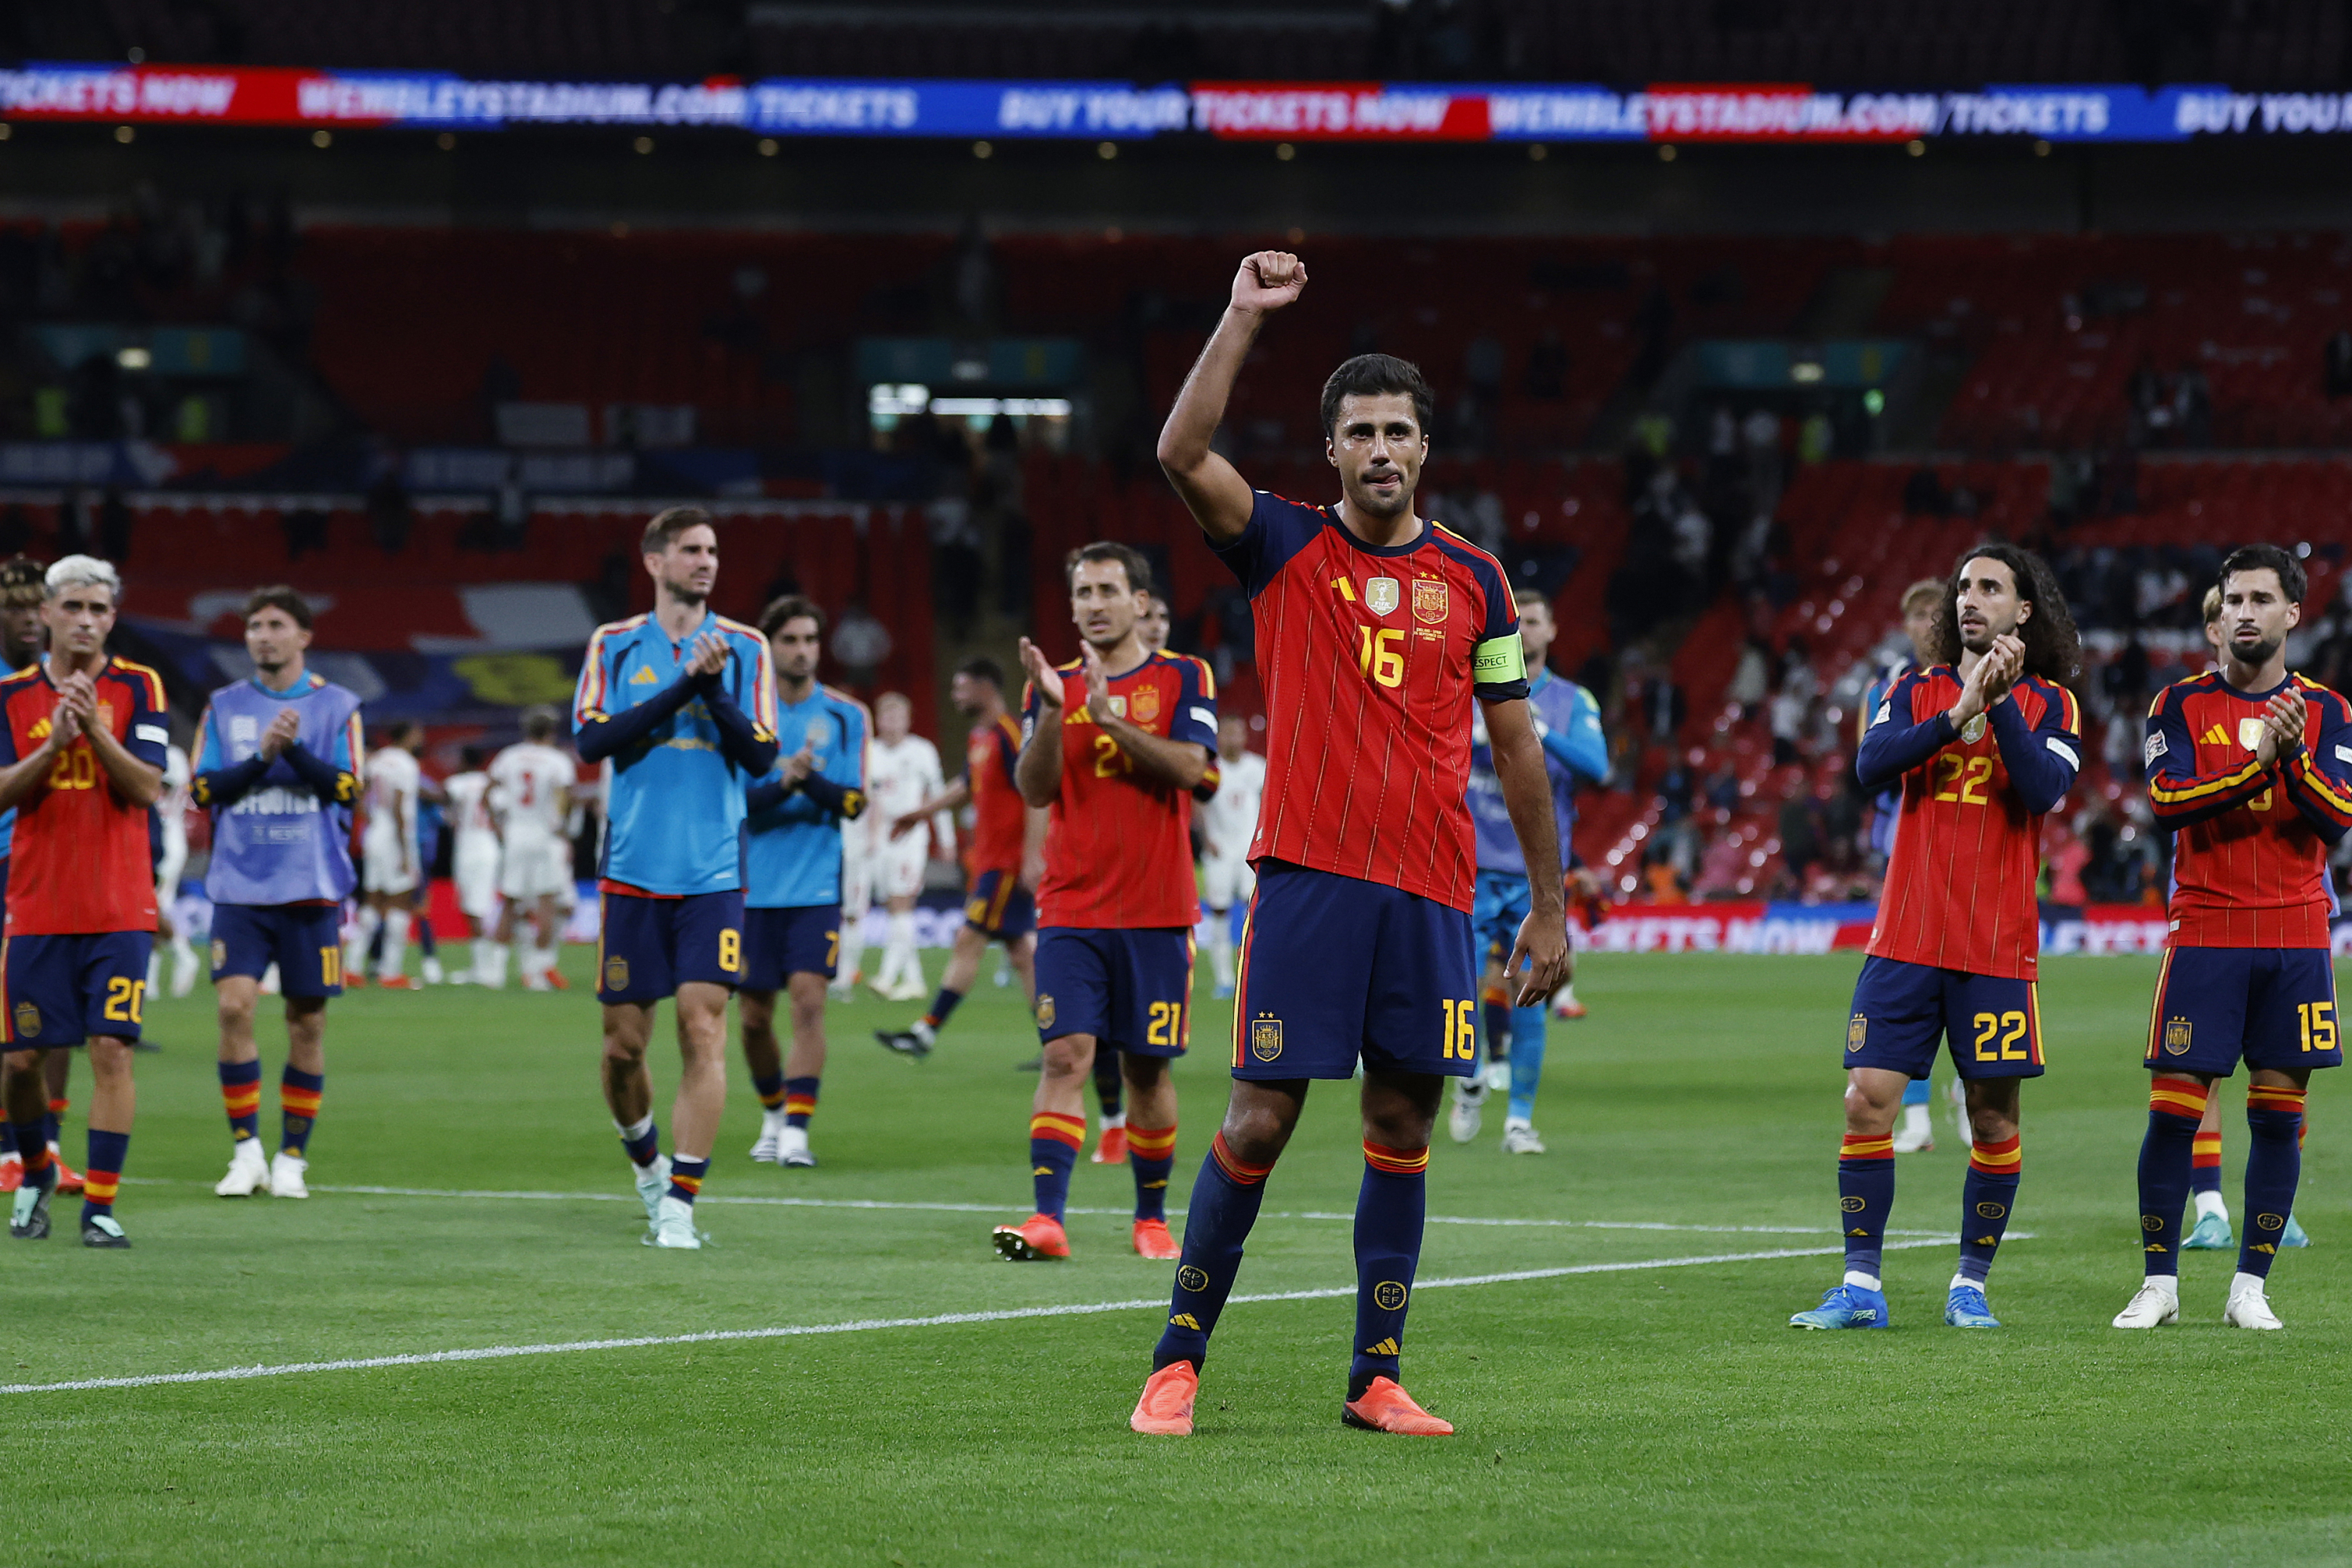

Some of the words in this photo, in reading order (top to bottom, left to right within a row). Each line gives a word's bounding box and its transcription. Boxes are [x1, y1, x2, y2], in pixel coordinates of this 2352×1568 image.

[0, 67, 136, 114] ICKETS
[138, 71, 237, 117] NOW
[999, 86, 1082, 132] BUY
[1083, 86, 1188, 132] YOUR
[1189, 90, 1349, 132] TICKETS
[1350, 90, 1450, 132] NOW
[2176, 92, 2259, 135] BUY
[1359, 624, 1406, 688] 16
[1475, 655, 1507, 668] ESPECT
[49, 749, 96, 790] 20
[1934, 753, 1993, 806] 22
[718, 927, 741, 973] 8
[1726, 914, 1840, 956] NOW
[1147, 1000, 1181, 1047] 21
[1443, 998, 1475, 1061] 16
[1973, 1011, 2027, 1062] 22
[2297, 1000, 2336, 1052] 15
[1382, 1287, 1400, 1295] RF
[1382, 1295, 1399, 1304] EF
